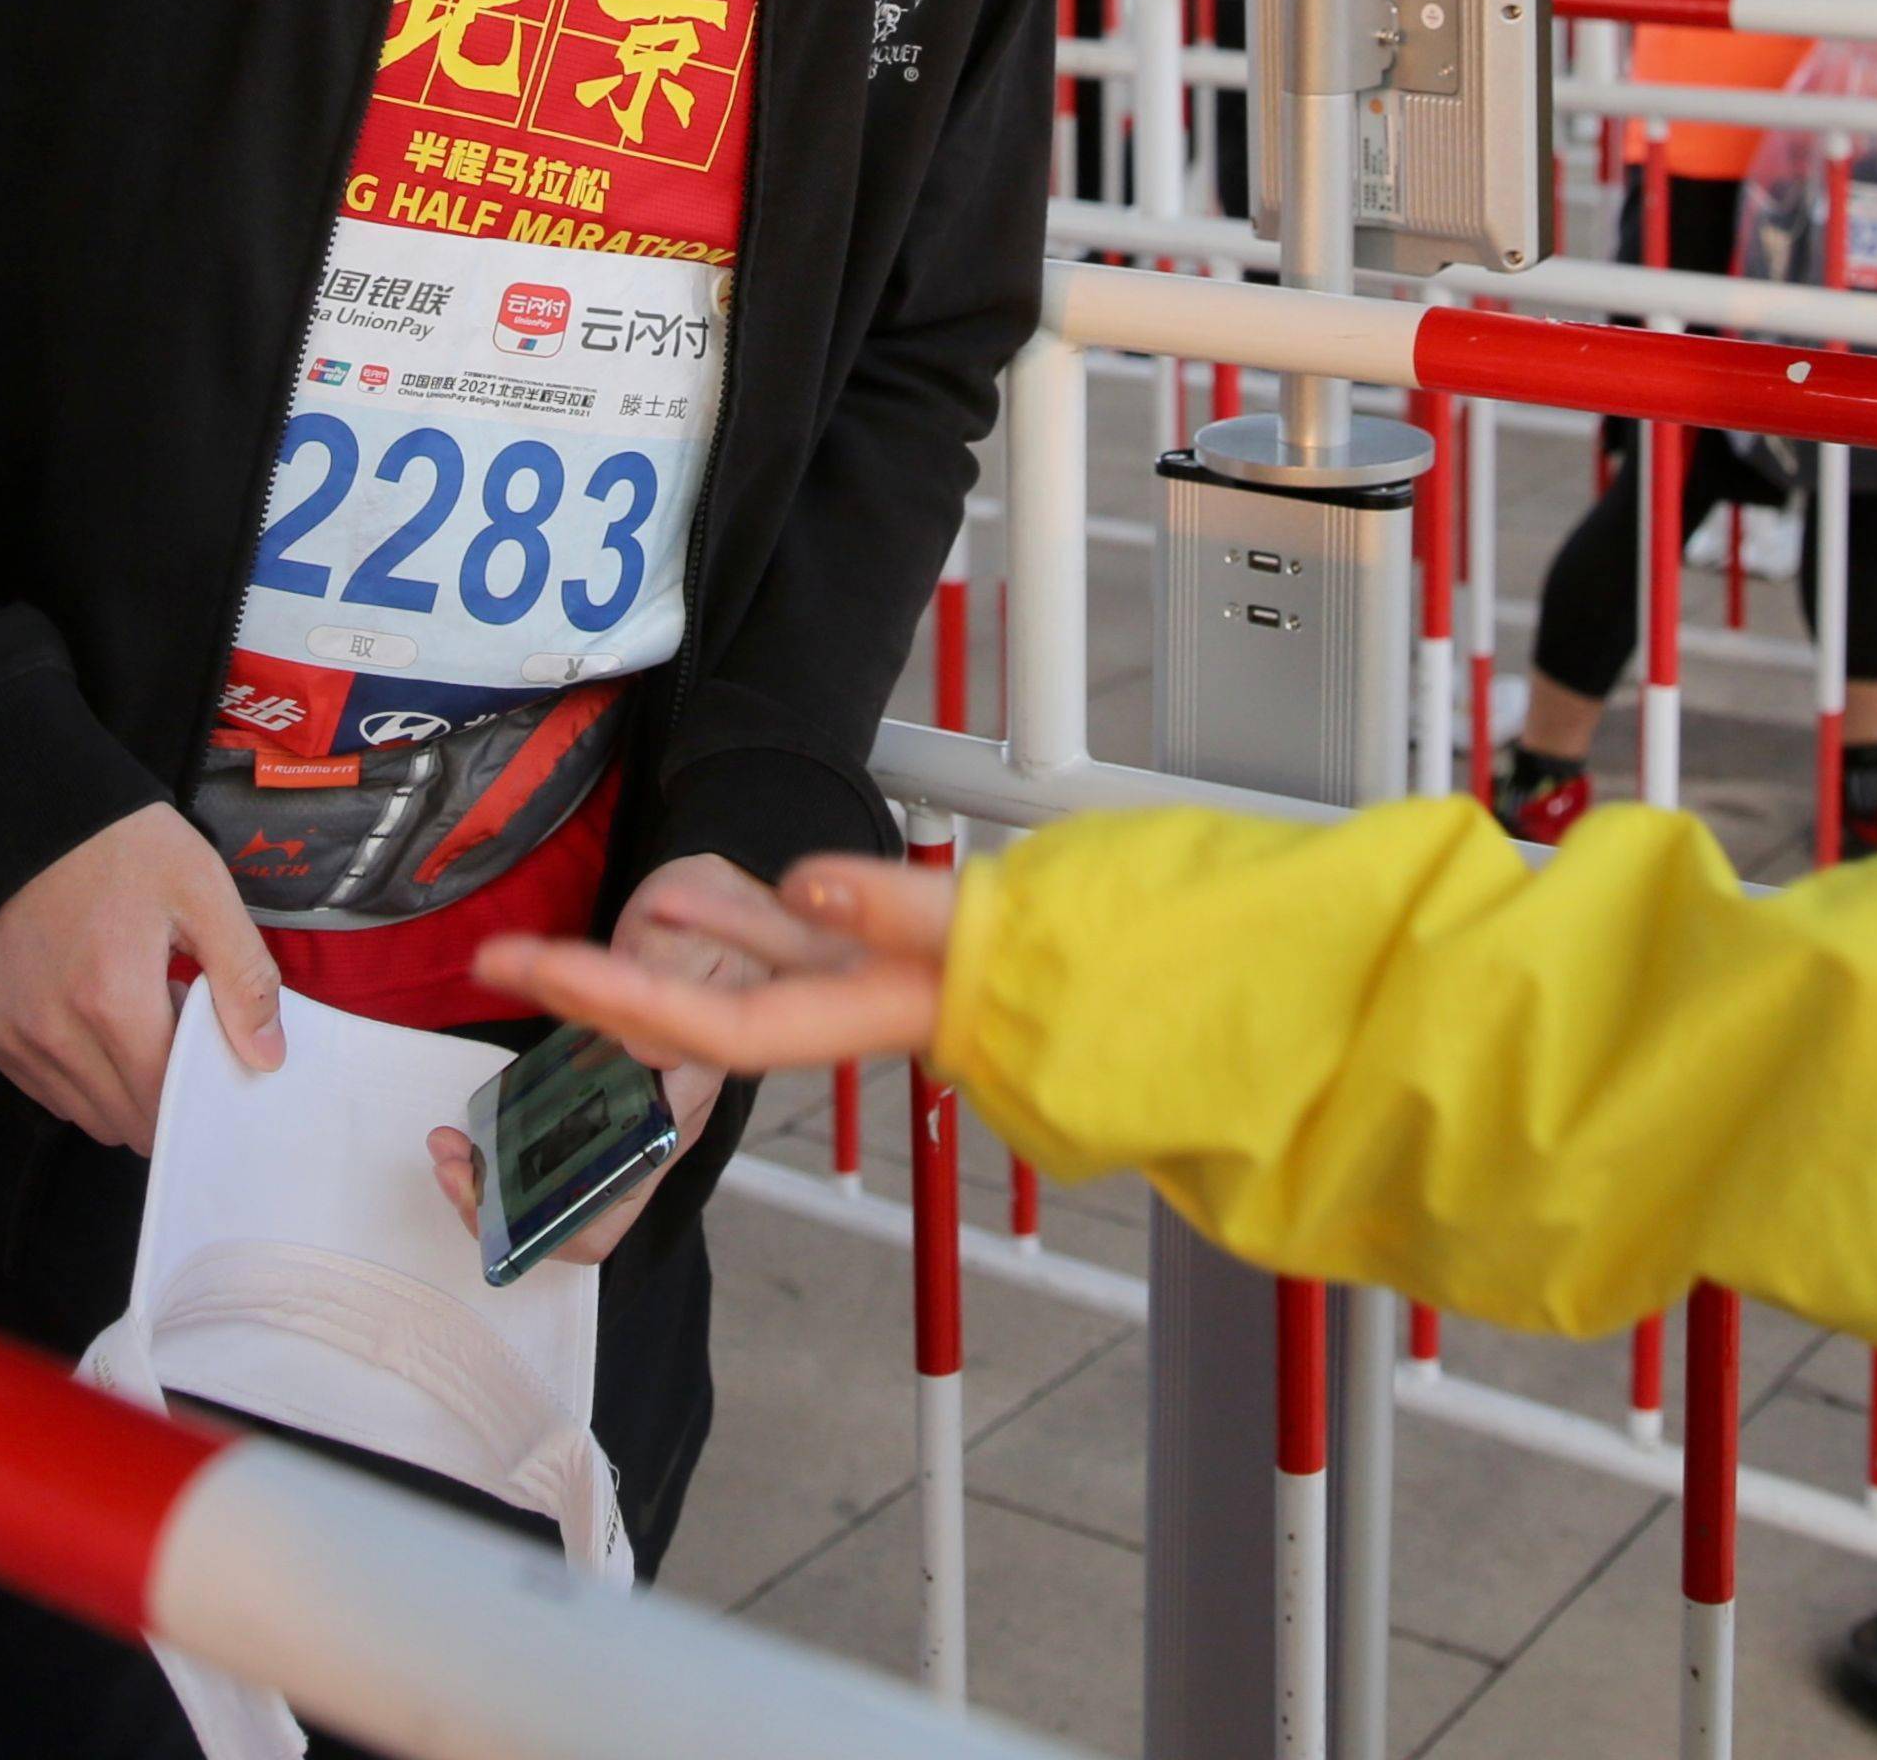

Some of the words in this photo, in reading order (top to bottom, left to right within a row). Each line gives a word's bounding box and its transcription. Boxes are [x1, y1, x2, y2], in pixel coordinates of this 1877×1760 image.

[404, 130, 611, 215] 半程马拉松
[387, 183, 503, 236] HALF
[507, 210, 735, 265] MARATHON
[337, 306, 435, 341] UnionPay
[398, 388, 423, 398] China
[426, 391, 467, 403] UnionPay
[468, 395, 500, 408] Beijing
[502, 398, 521, 409] Half
[523, 402, 566, 415] Marathon
[251, 412, 658, 633] 2283
[350, 634, 375, 658] 取
